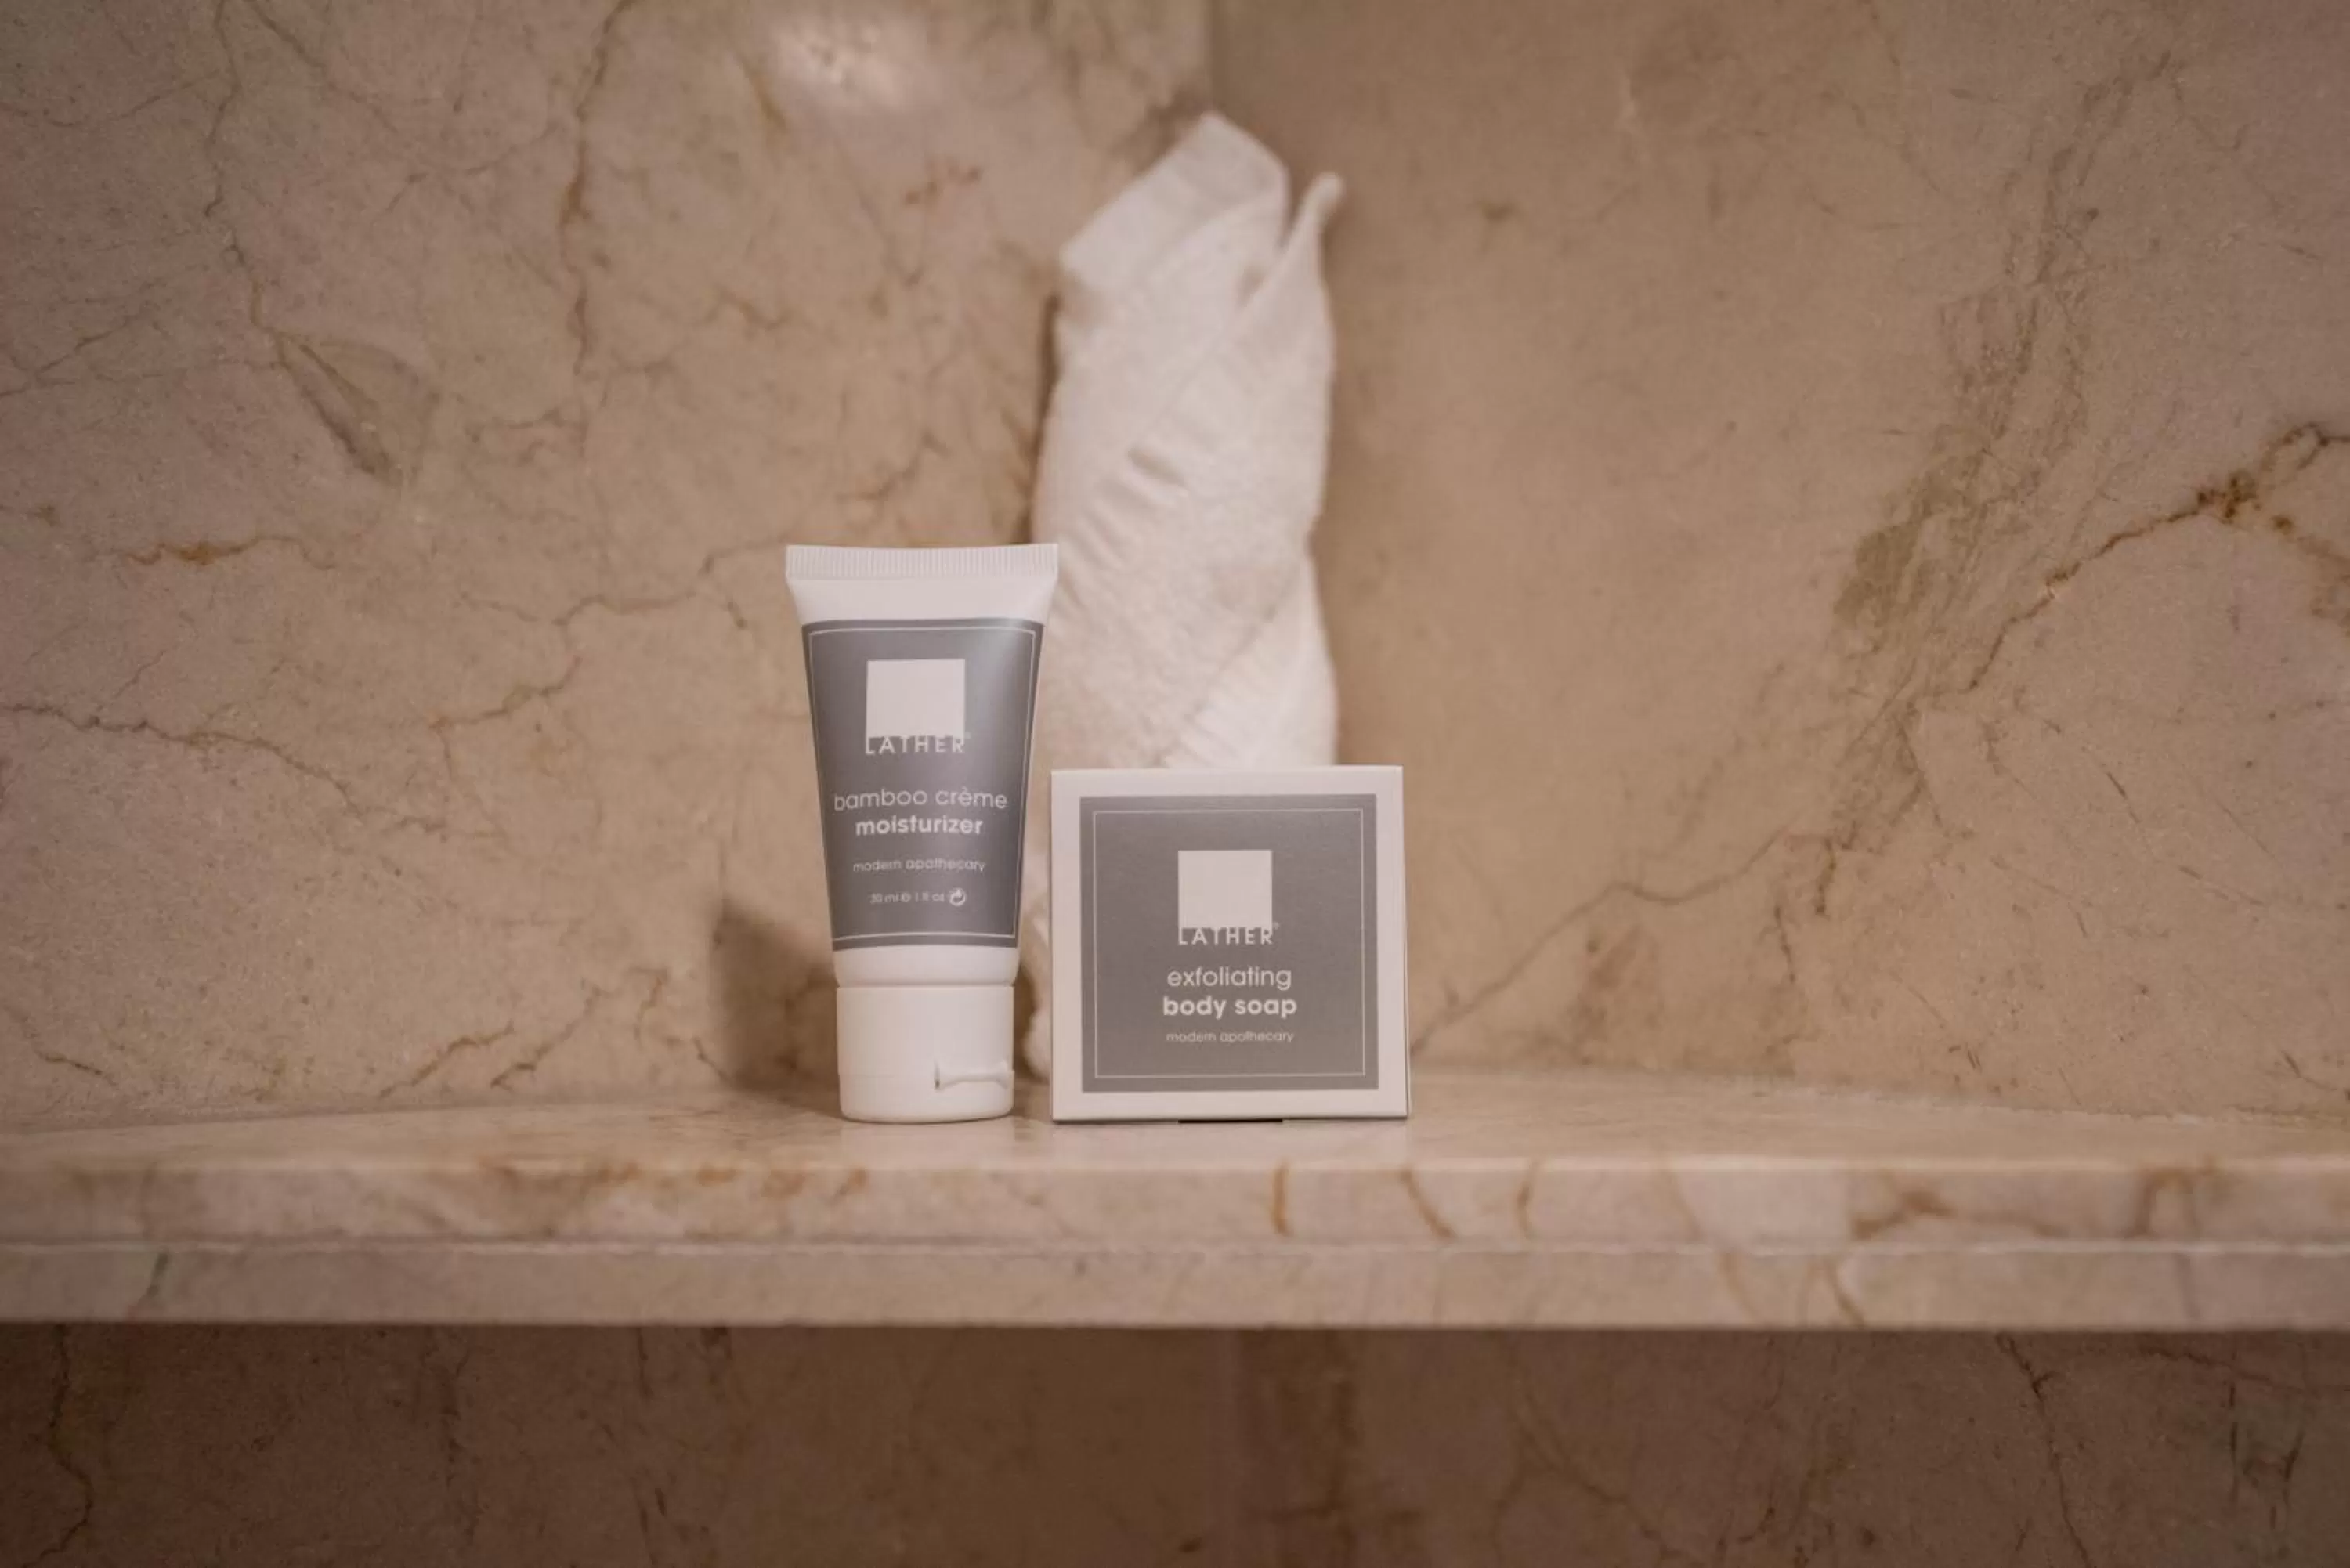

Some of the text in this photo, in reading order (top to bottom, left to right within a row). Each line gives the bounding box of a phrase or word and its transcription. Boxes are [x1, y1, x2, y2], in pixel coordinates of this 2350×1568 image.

[865, 735, 965, 755] LATHER
[833, 786, 1007, 811] bamboo crème
[855, 815, 984, 836] moisturizer
[852, 858, 986, 873] modern apothecary
[1177, 927, 1274, 945] LATHER
[1167, 966, 1292, 991] exfoliating
[1163, 996, 1297, 1020] body soap
[1166, 1031, 1294, 1043] modern apothecary
